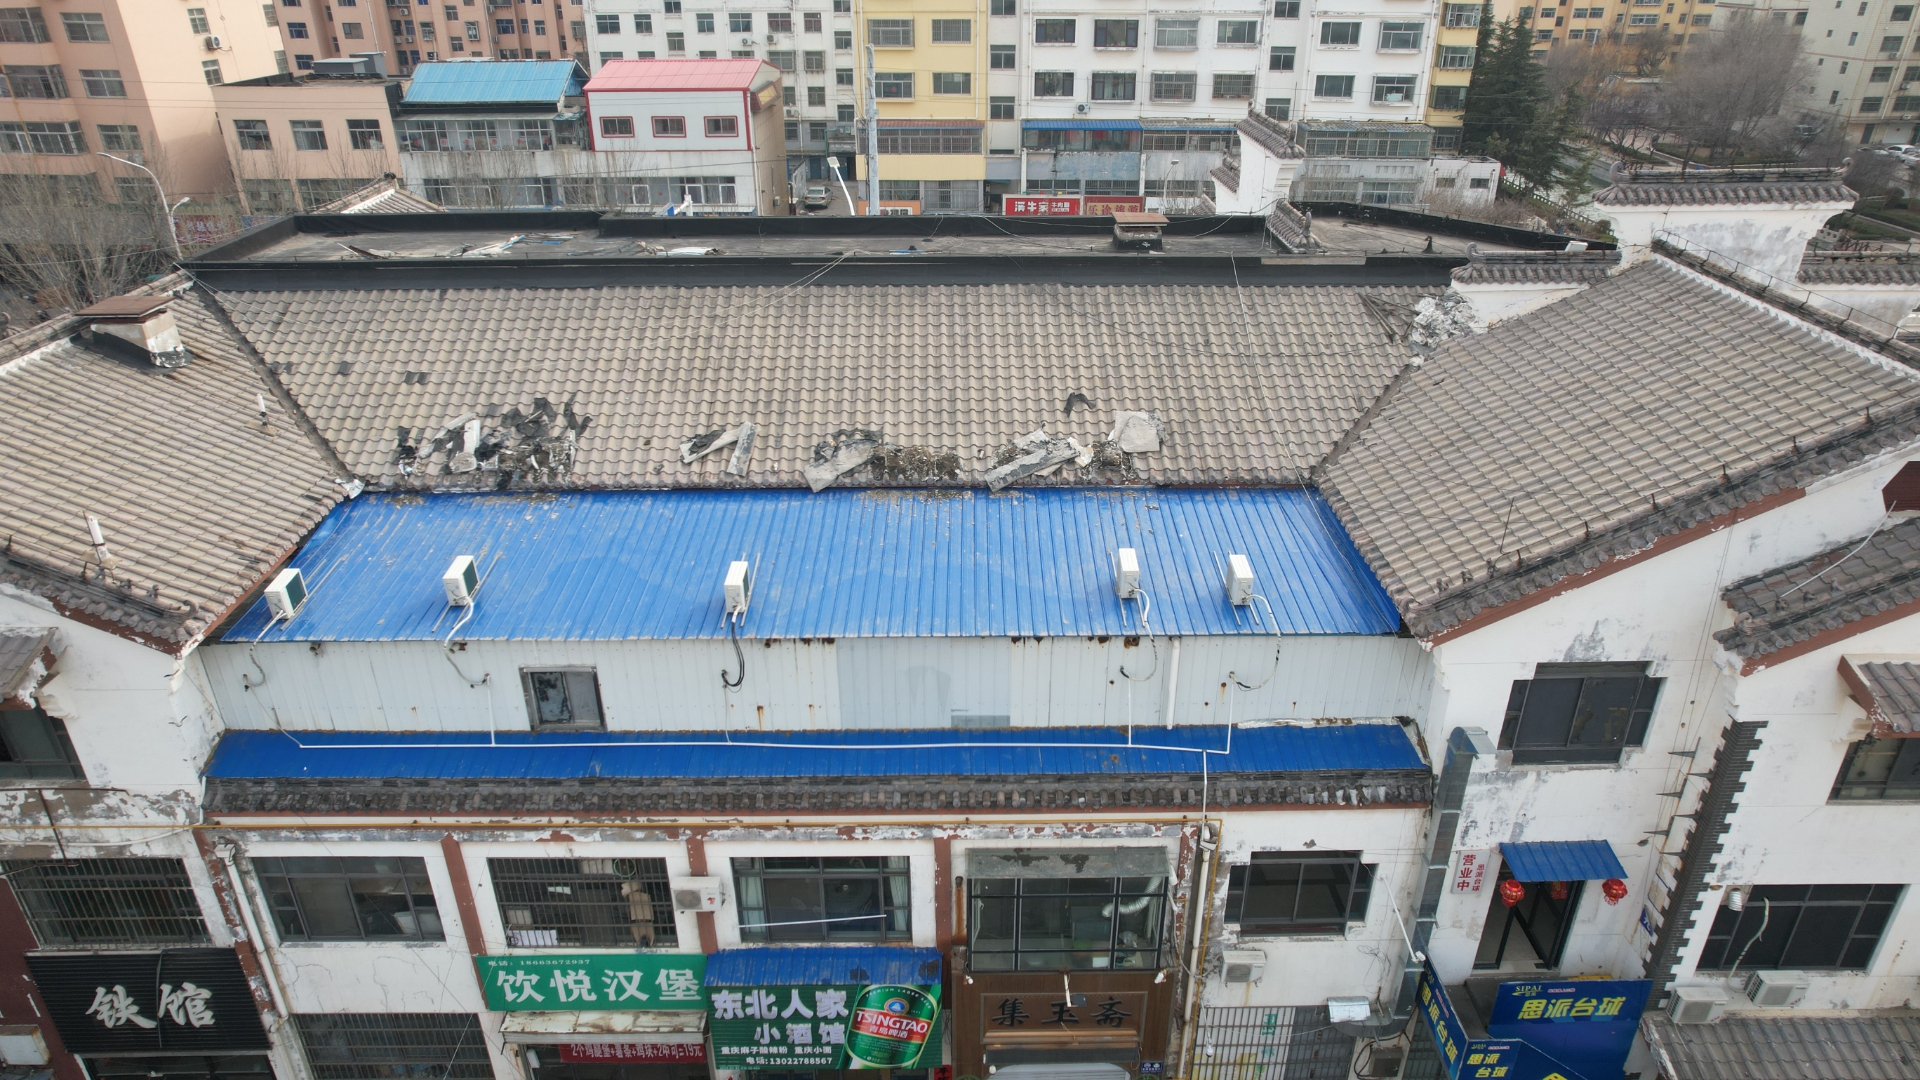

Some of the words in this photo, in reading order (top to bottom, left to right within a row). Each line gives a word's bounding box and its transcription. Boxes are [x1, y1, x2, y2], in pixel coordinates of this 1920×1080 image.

[1457, 854, 1476, 891] 营业中
[1471, 864, 1484, 891] 思派台球
[496, 968, 702, 1003] 饮悦汉堡
[85, 982, 215, 1029] 铁馆
[711, 988, 849, 1020] 东北人家
[991, 996, 1132, 1028] 集玉斋
[1517, 996, 1626, 1019] 思派台球
[754, 1022, 846, 1045] 小酒馆
[856, 1010, 928, 1034] TSINGTAO
[869, 1025, 909, 1039] 青岛啤酒
[1422, 982, 1458, 1065] 思派台球
[721, 1046, 788, 1055] 重庆麻子酸辣粉
[794, 1046, 832, 1054] 重庆小面
[746, 1056, 833, 1065] 电话:13022788567
[1466, 1053, 1501, 1065] 思派
[1475, 1066, 1508, 1078] 台球
